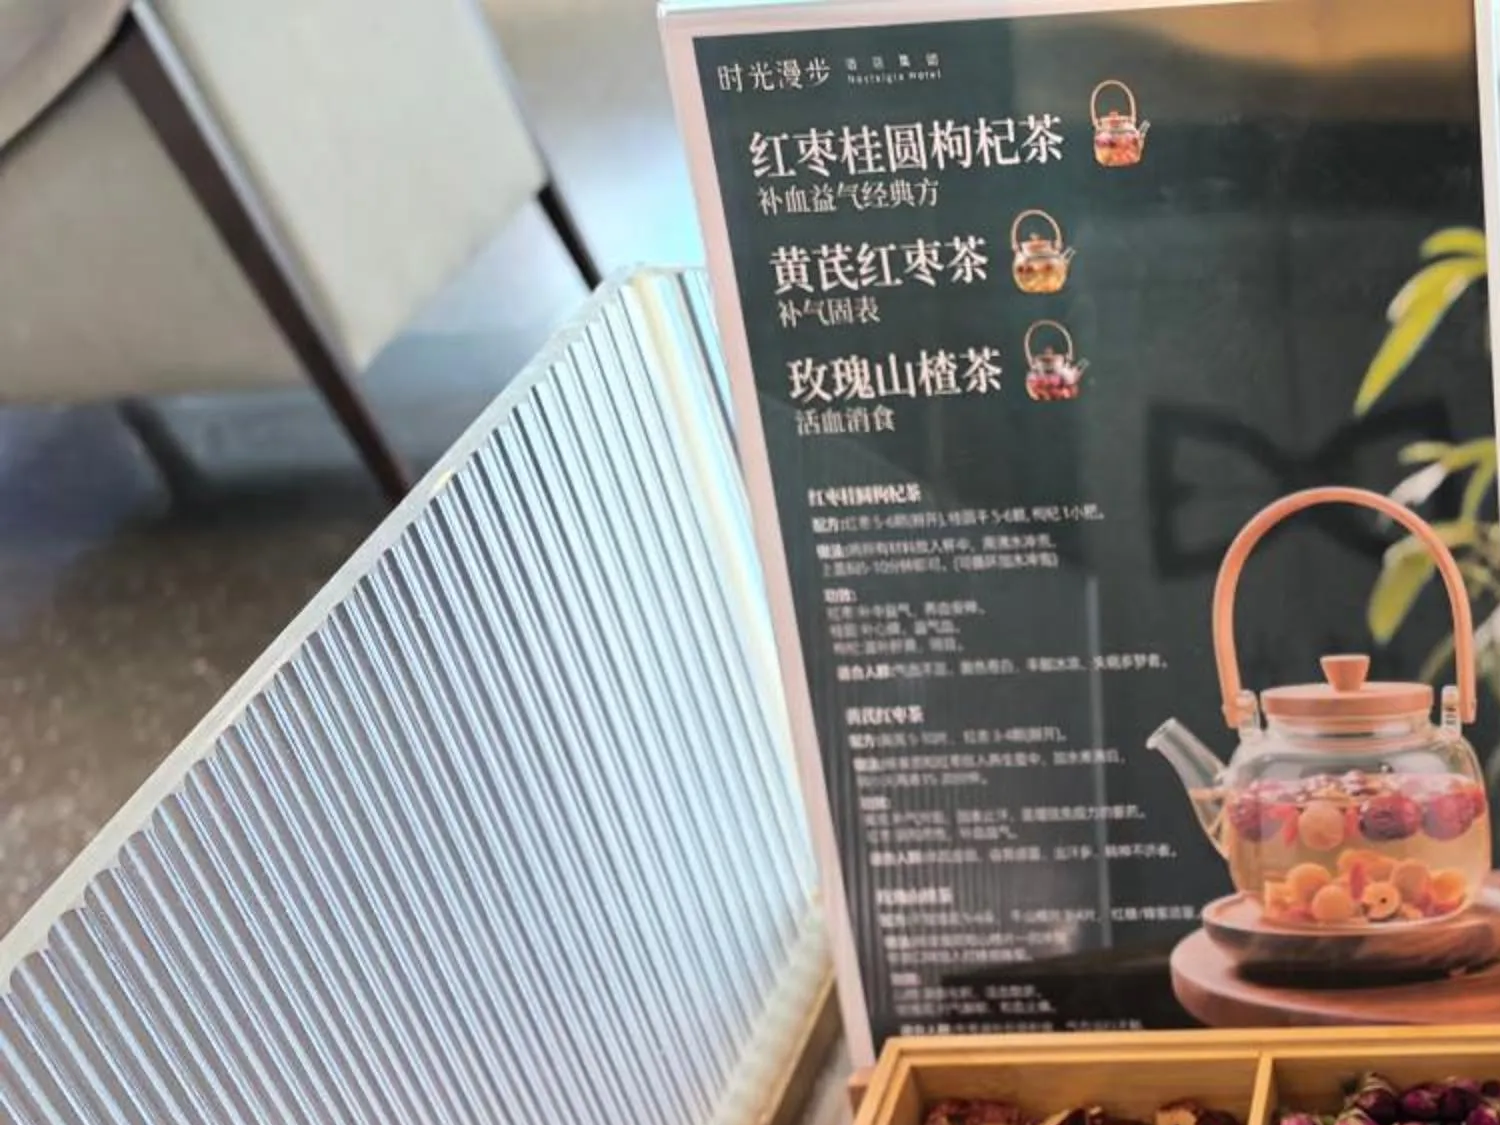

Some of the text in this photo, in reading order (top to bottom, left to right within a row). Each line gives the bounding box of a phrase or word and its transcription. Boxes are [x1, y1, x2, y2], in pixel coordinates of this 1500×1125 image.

[717, 56, 831, 93] 时光漫步
[748, 113, 1066, 178] 红枣桂圆枸杞茶
[757, 177, 940, 217] 补血益气经典方
[769, 235, 990, 295] 黄芪红枣茶
[777, 296, 881, 328] 补气固表
[786, 346, 1004, 403] 玫瑰山楂茶
[795, 404, 897, 436] 活血消食
